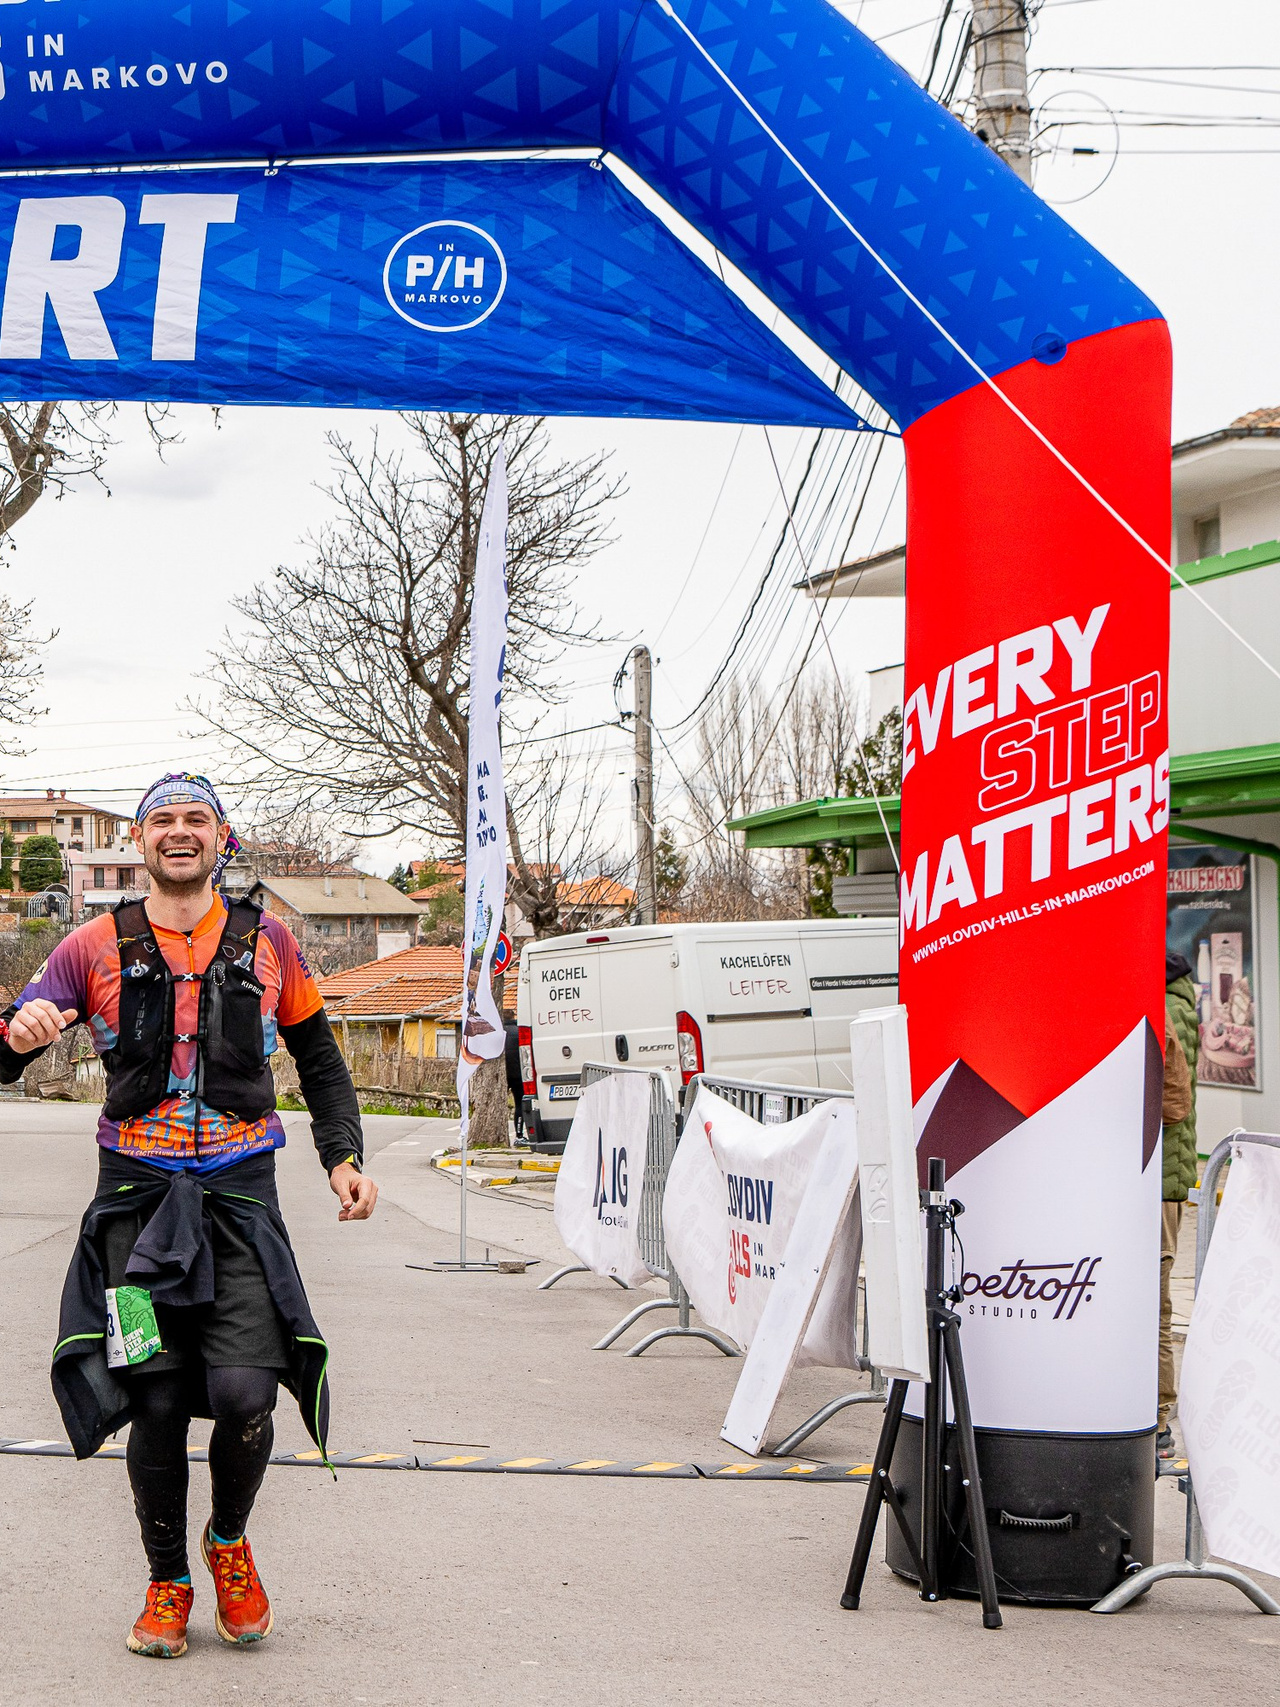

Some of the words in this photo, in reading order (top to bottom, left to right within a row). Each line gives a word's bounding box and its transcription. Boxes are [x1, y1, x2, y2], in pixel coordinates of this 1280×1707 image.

[27, 34, 64, 57] IN
[29, 61, 229, 92] MARKOVO
[438, 243, 455, 252] IN
[405, 254, 485, 291] P/H
[404, 293, 483, 305] MARKOVO
[902, 602, 1111, 783] EVERY
[978, 671, 1161, 812] STEP
[900, 748, 1170, 951] MATTERS
[912, 860, 1155, 963] WWW.PLOVDIV-HILLS-IN-MARKOVO.COM
[720, 952, 792, 969] KACHELÖFEN
[541, 966, 588, 983] KACHEL
[241, 979, 264, 997] KIPRUN
[548, 986, 581, 1002] ÖFEN
[728, 978, 792, 997] LEITER
[537, 1008, 594, 1026] LEITER
[638, 1044, 675, 1053] DUCATO
[565, 1086, 580, 1096] 027
[754, 1242, 764, 1256] IN
[969, 1304, 1037, 1320] STUDIO
